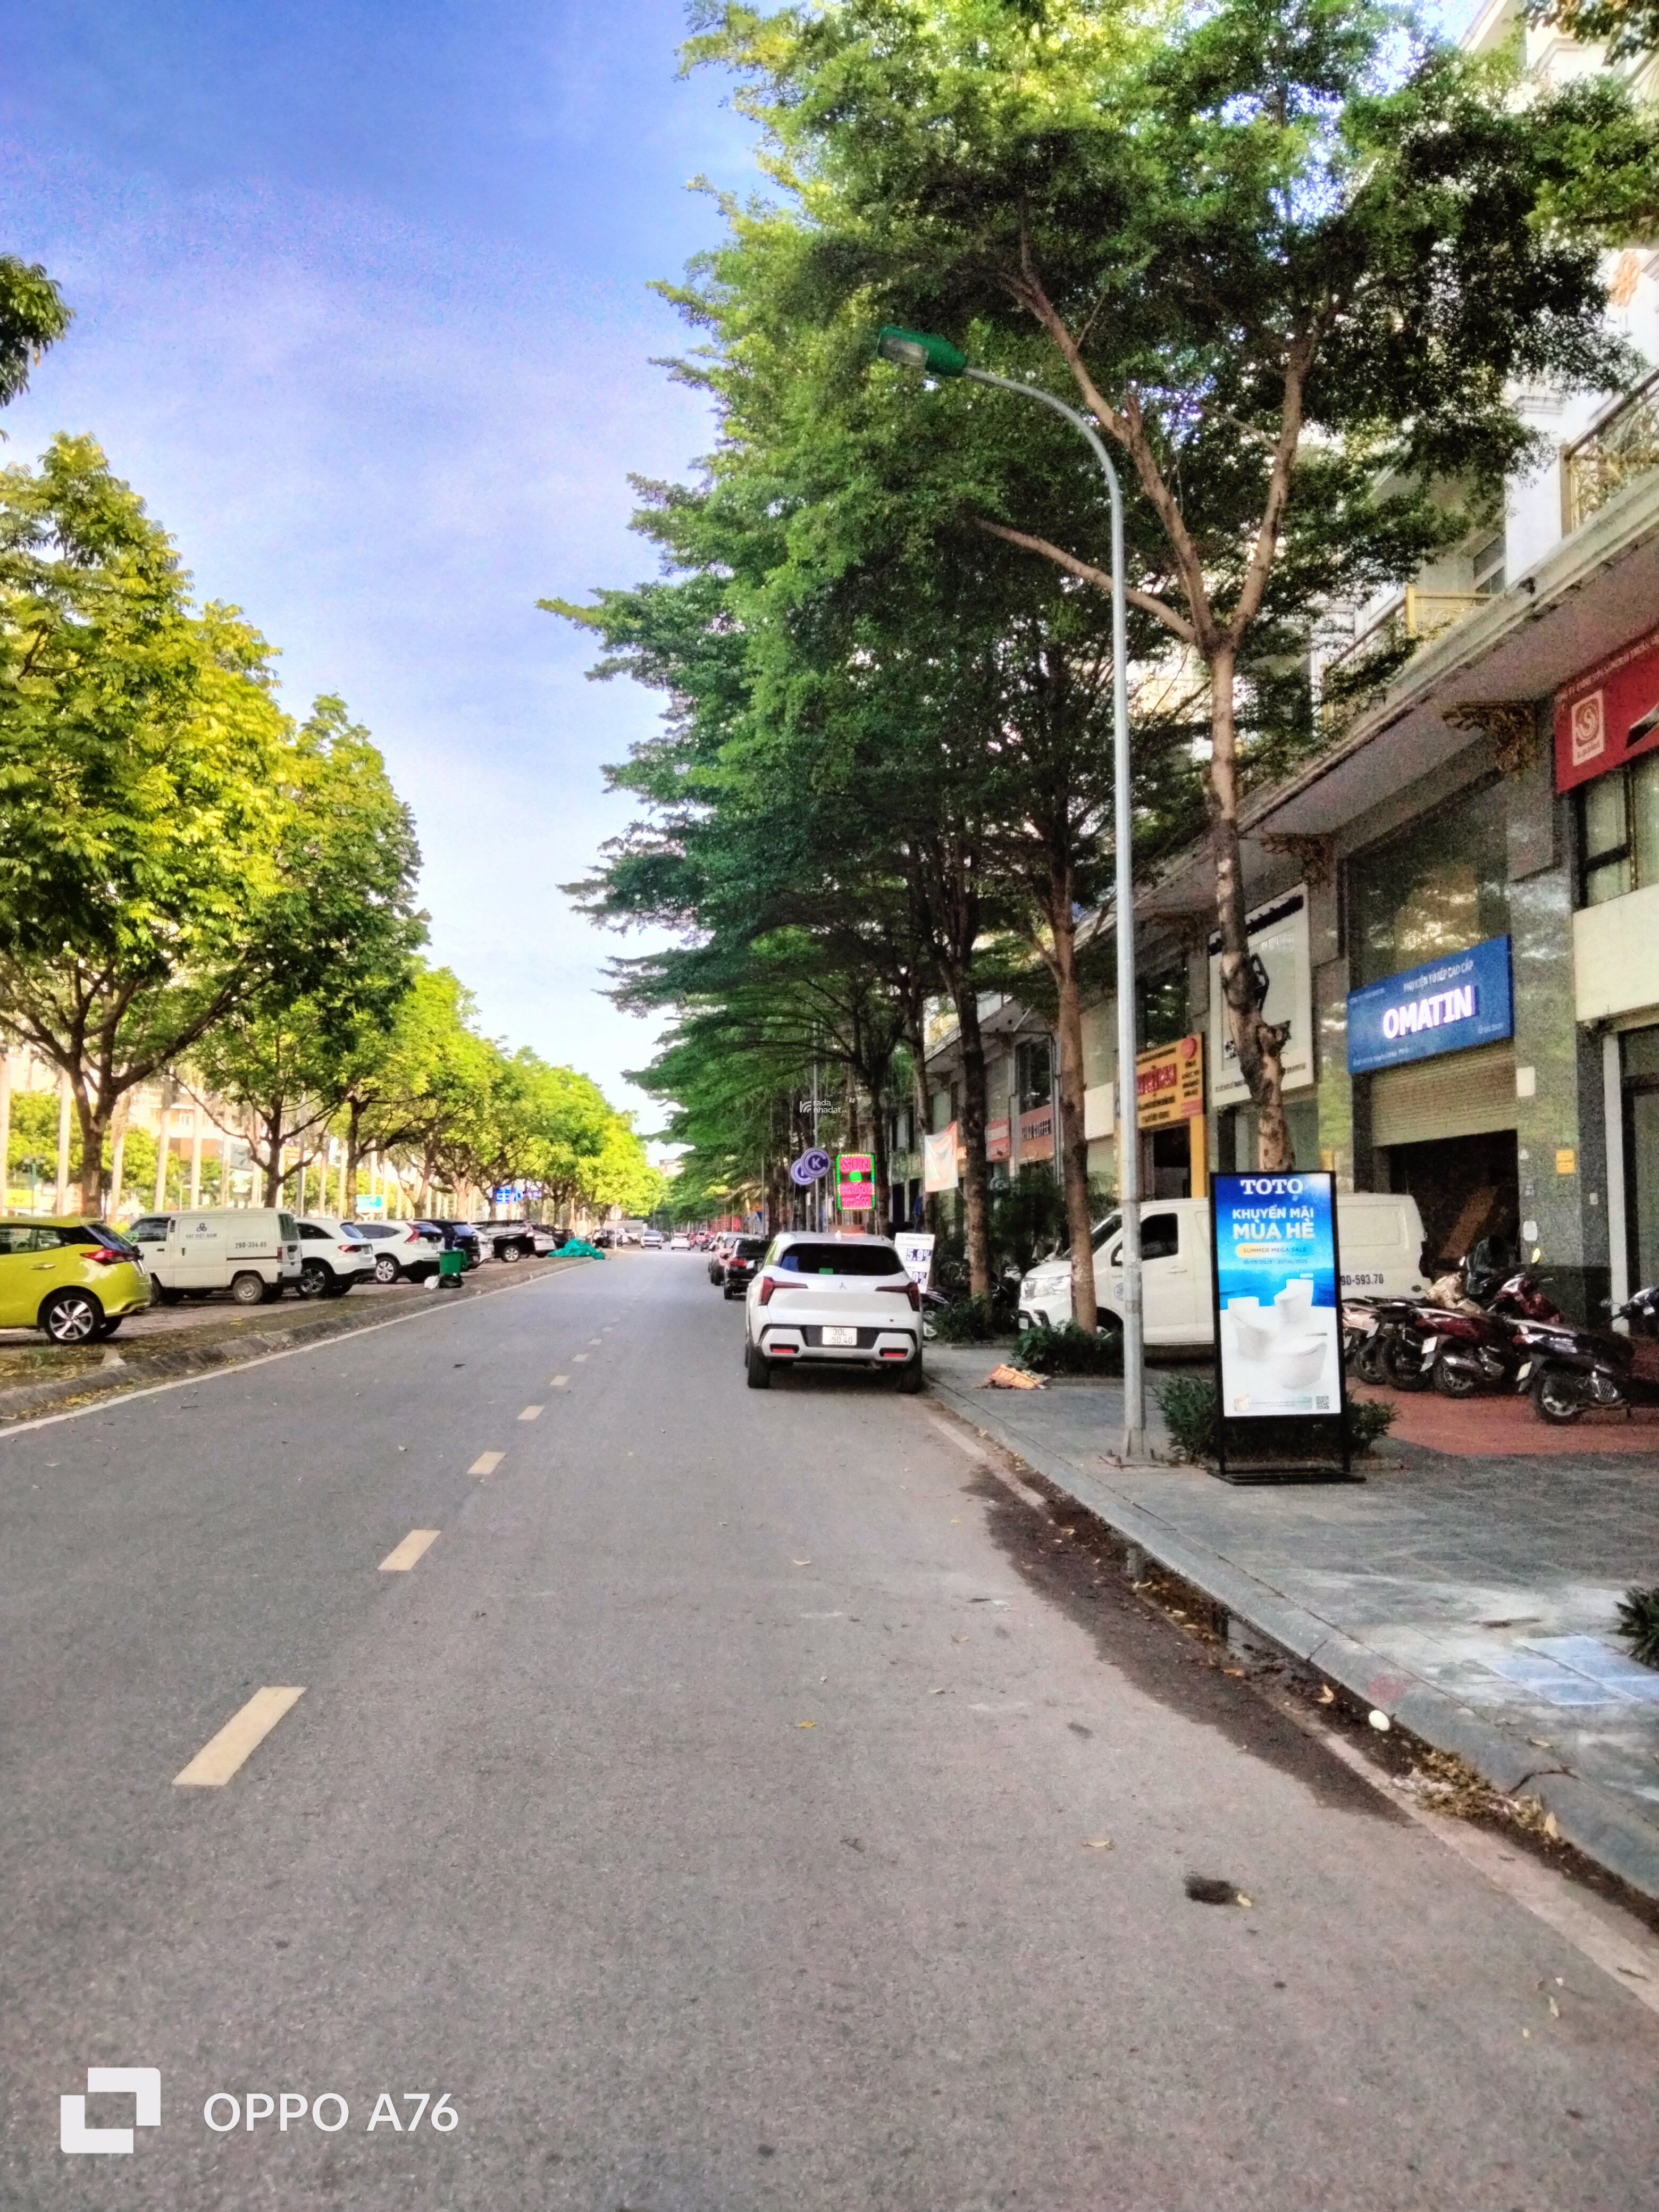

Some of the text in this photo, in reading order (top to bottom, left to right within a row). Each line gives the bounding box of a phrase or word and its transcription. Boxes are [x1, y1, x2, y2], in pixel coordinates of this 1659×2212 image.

[1382, 984, 1474, 1040] OMATIN
[1241, 1178, 1303, 1195] TOTO
[1232, 1204, 1286, 1219] KHUYẾN
[1233, 1217, 1315, 1240] MÙA HÈ
[1340, 1273, 1384, 1286] 9D-593.70
